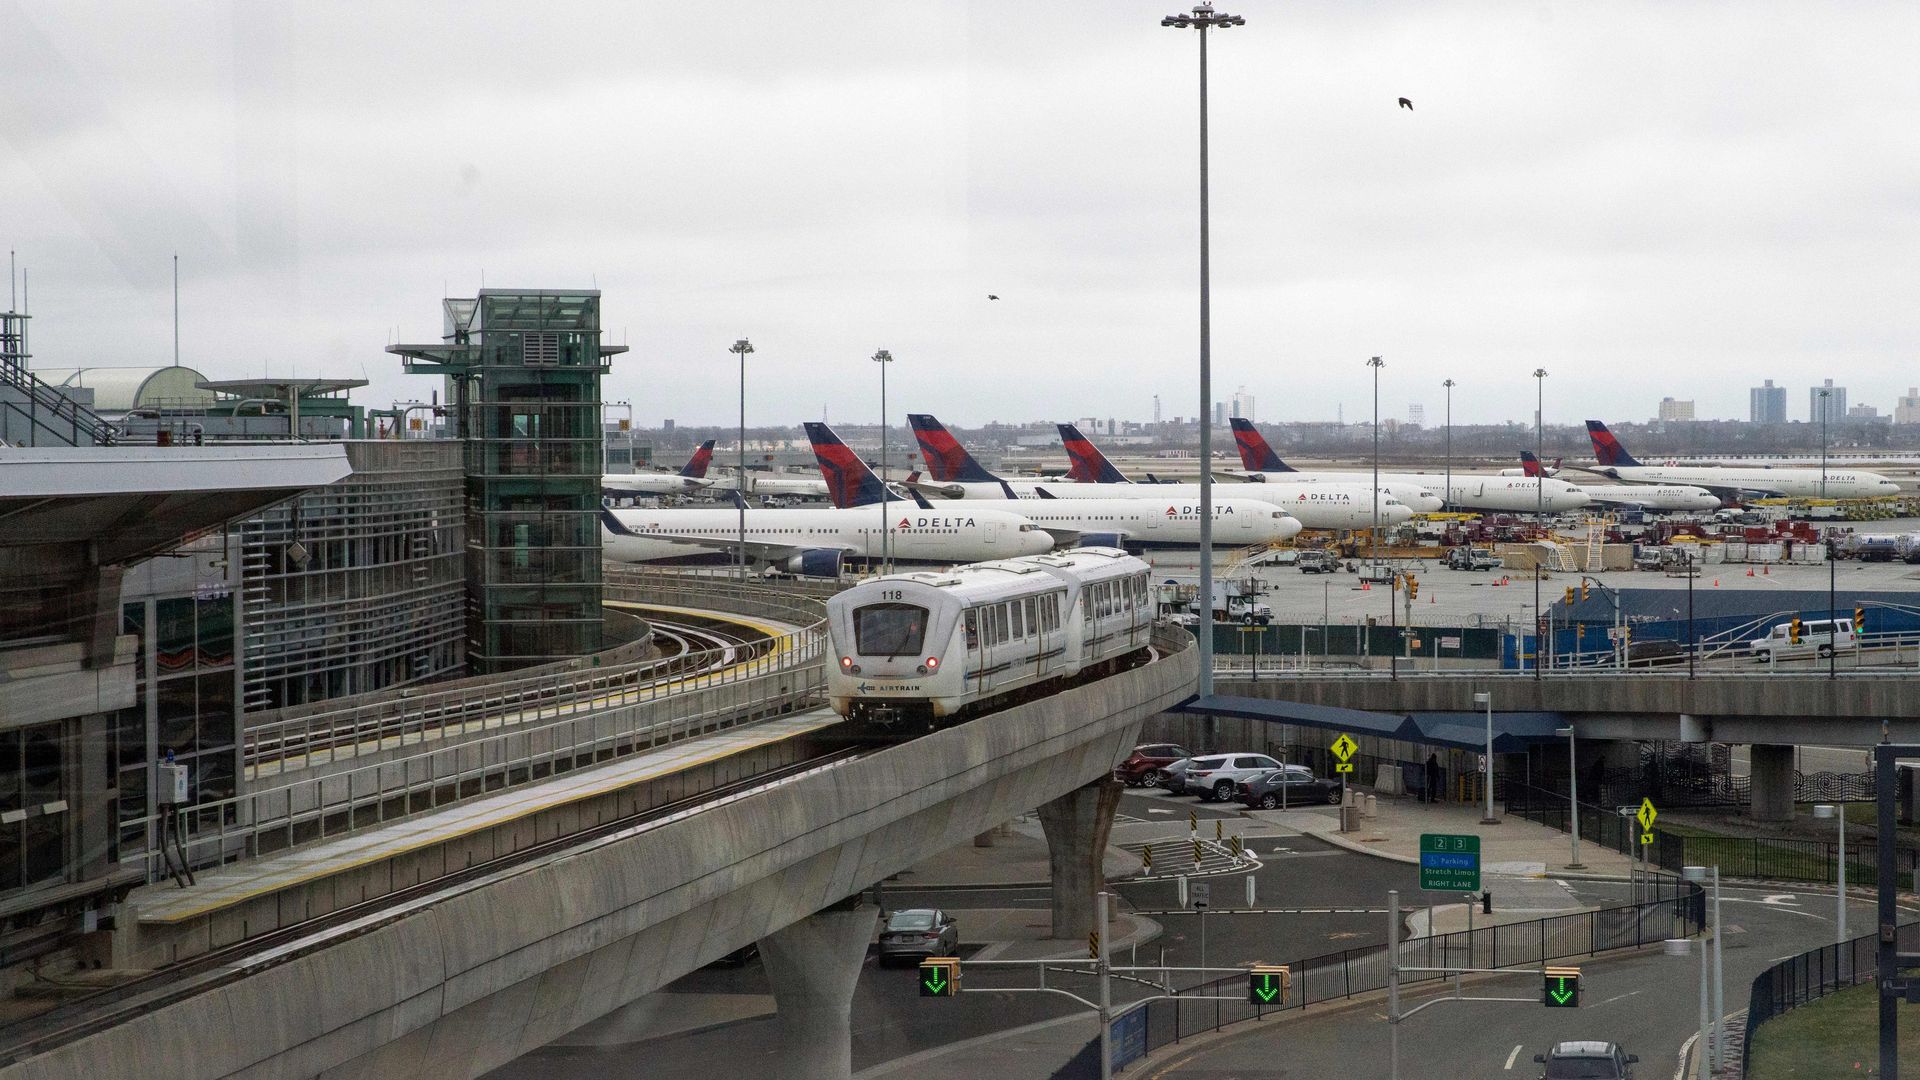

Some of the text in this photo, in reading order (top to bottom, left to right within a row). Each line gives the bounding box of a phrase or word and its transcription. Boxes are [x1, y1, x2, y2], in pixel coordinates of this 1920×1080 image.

[1183, 506, 1233, 514] DETA
[918, 518, 975, 527] DELTA
[882, 591, 902, 600] 118
[1437, 839, 1463, 848] 2 3
[1441, 858, 1469, 866] Parking
